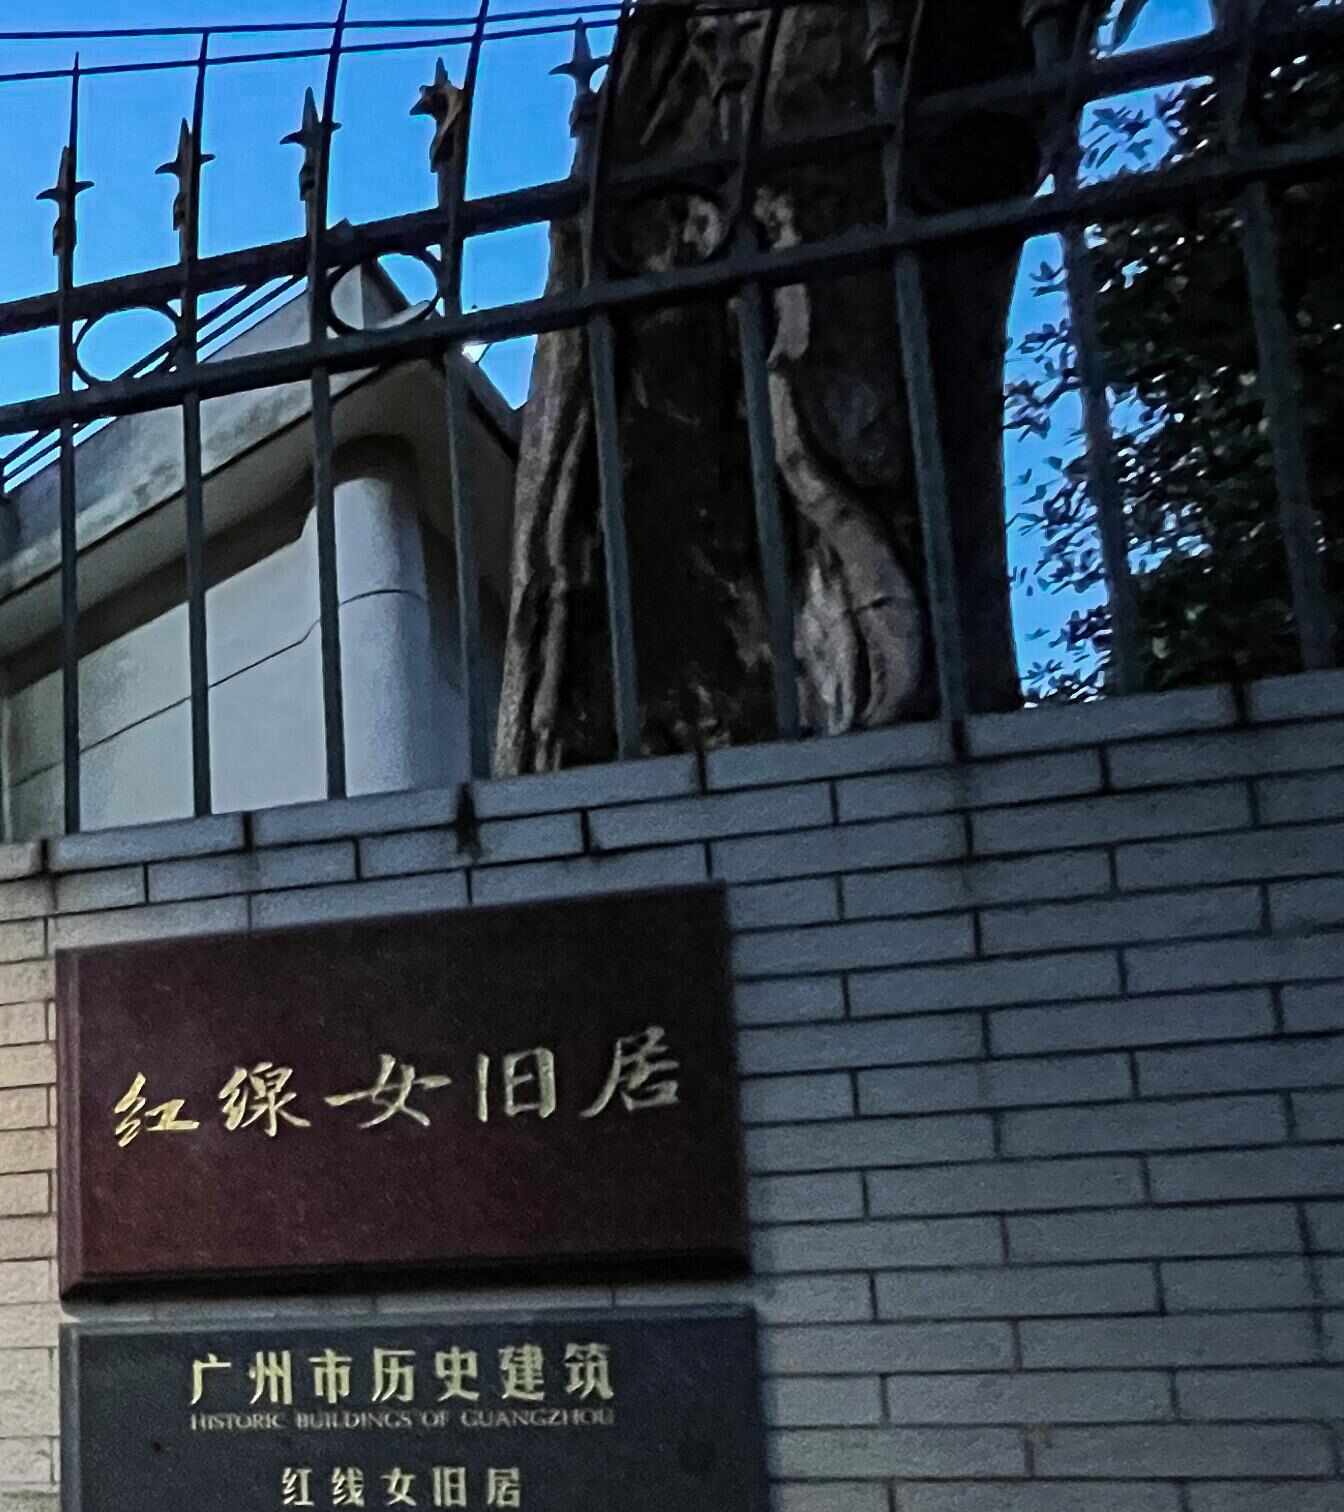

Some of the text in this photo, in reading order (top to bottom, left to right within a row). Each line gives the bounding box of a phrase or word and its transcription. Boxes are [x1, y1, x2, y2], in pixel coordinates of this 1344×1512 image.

[189, 1342, 616, 1407] 广州市历史建筑
[190, 1406, 616, 1433] HISTORIC BUILDINGS OF GUANGZHOU
[280, 1466, 522, 1510] 红线女旧居
